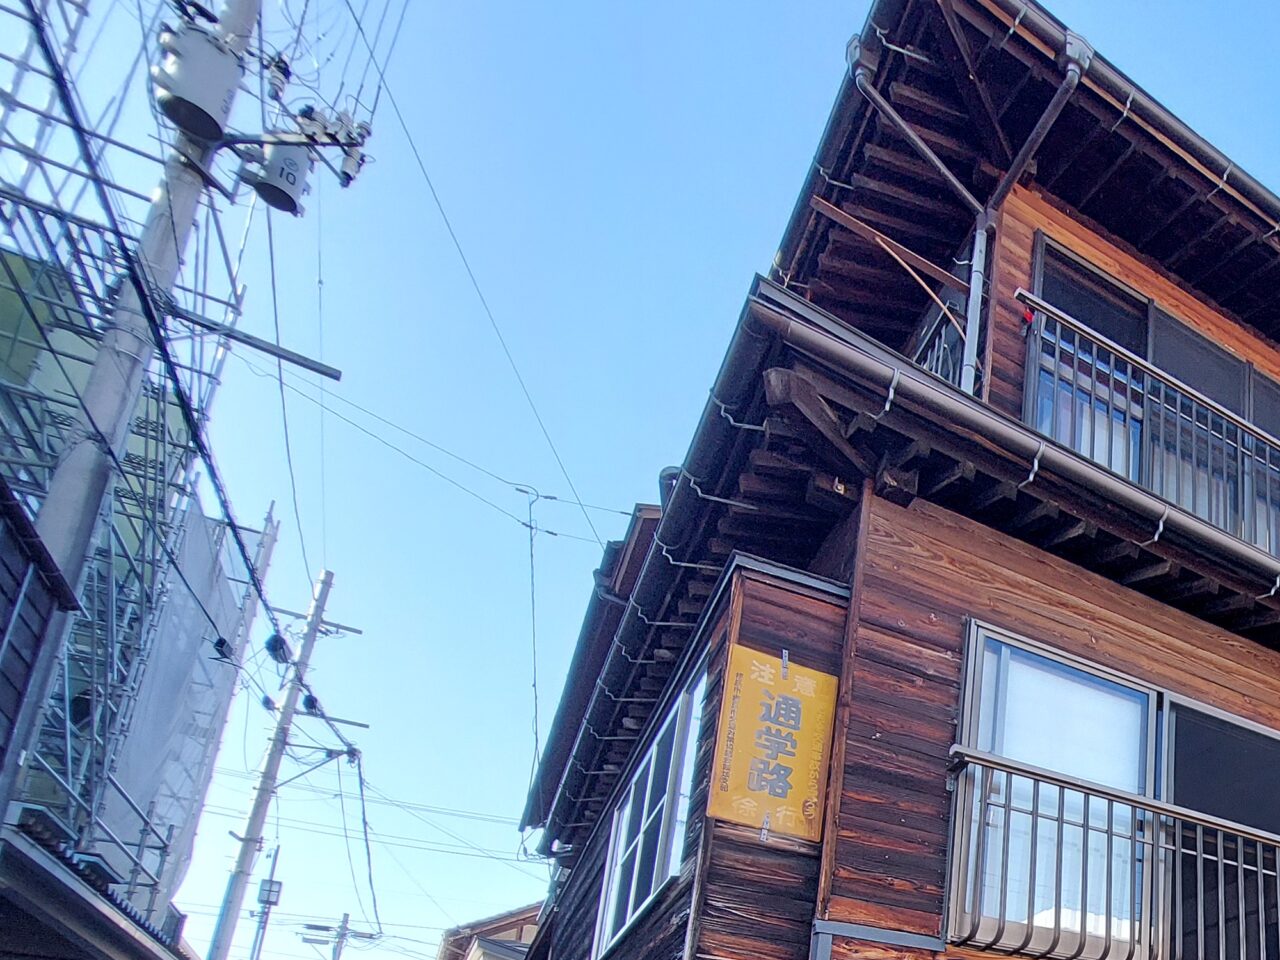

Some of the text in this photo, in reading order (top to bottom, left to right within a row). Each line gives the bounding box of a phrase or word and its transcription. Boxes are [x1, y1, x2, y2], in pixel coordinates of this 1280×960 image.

[278, 166, 297, 186] 10
[752, 659, 817, 697] 注意
[747, 688, 803, 798] 通学路
